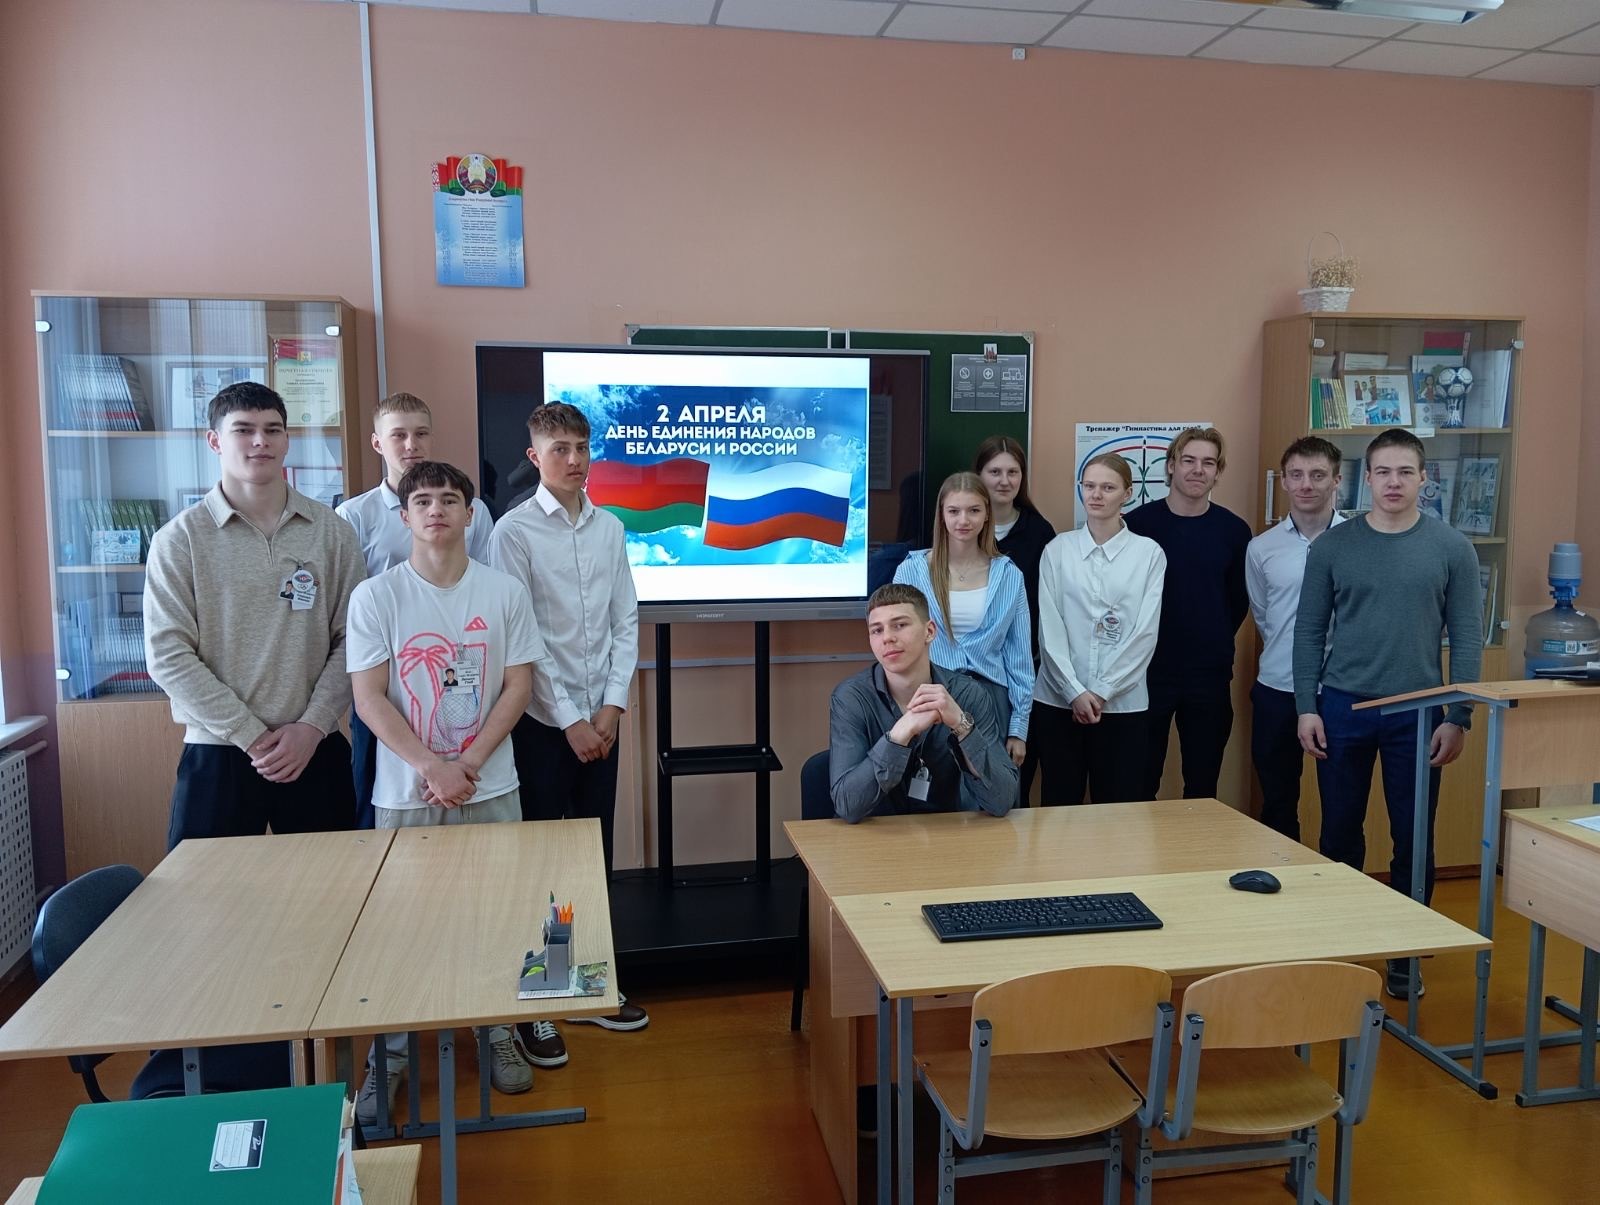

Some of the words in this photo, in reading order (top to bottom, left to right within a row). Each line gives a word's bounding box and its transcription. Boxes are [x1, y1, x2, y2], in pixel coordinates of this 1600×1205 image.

[656, 404, 670, 423] 2
[677, 405, 766, 423] АПРЕЛЯ
[605, 425, 649, 440] ДЕНЬ
[652, 425, 737, 440] ЕДИНЕНИЯ
[740, 426, 816, 441] НАРОДОВ
[626, 441, 711, 455] БЕЛАРУСИ
[714, 442, 726, 455] И
[729, 442, 798, 456] РОССИИ
